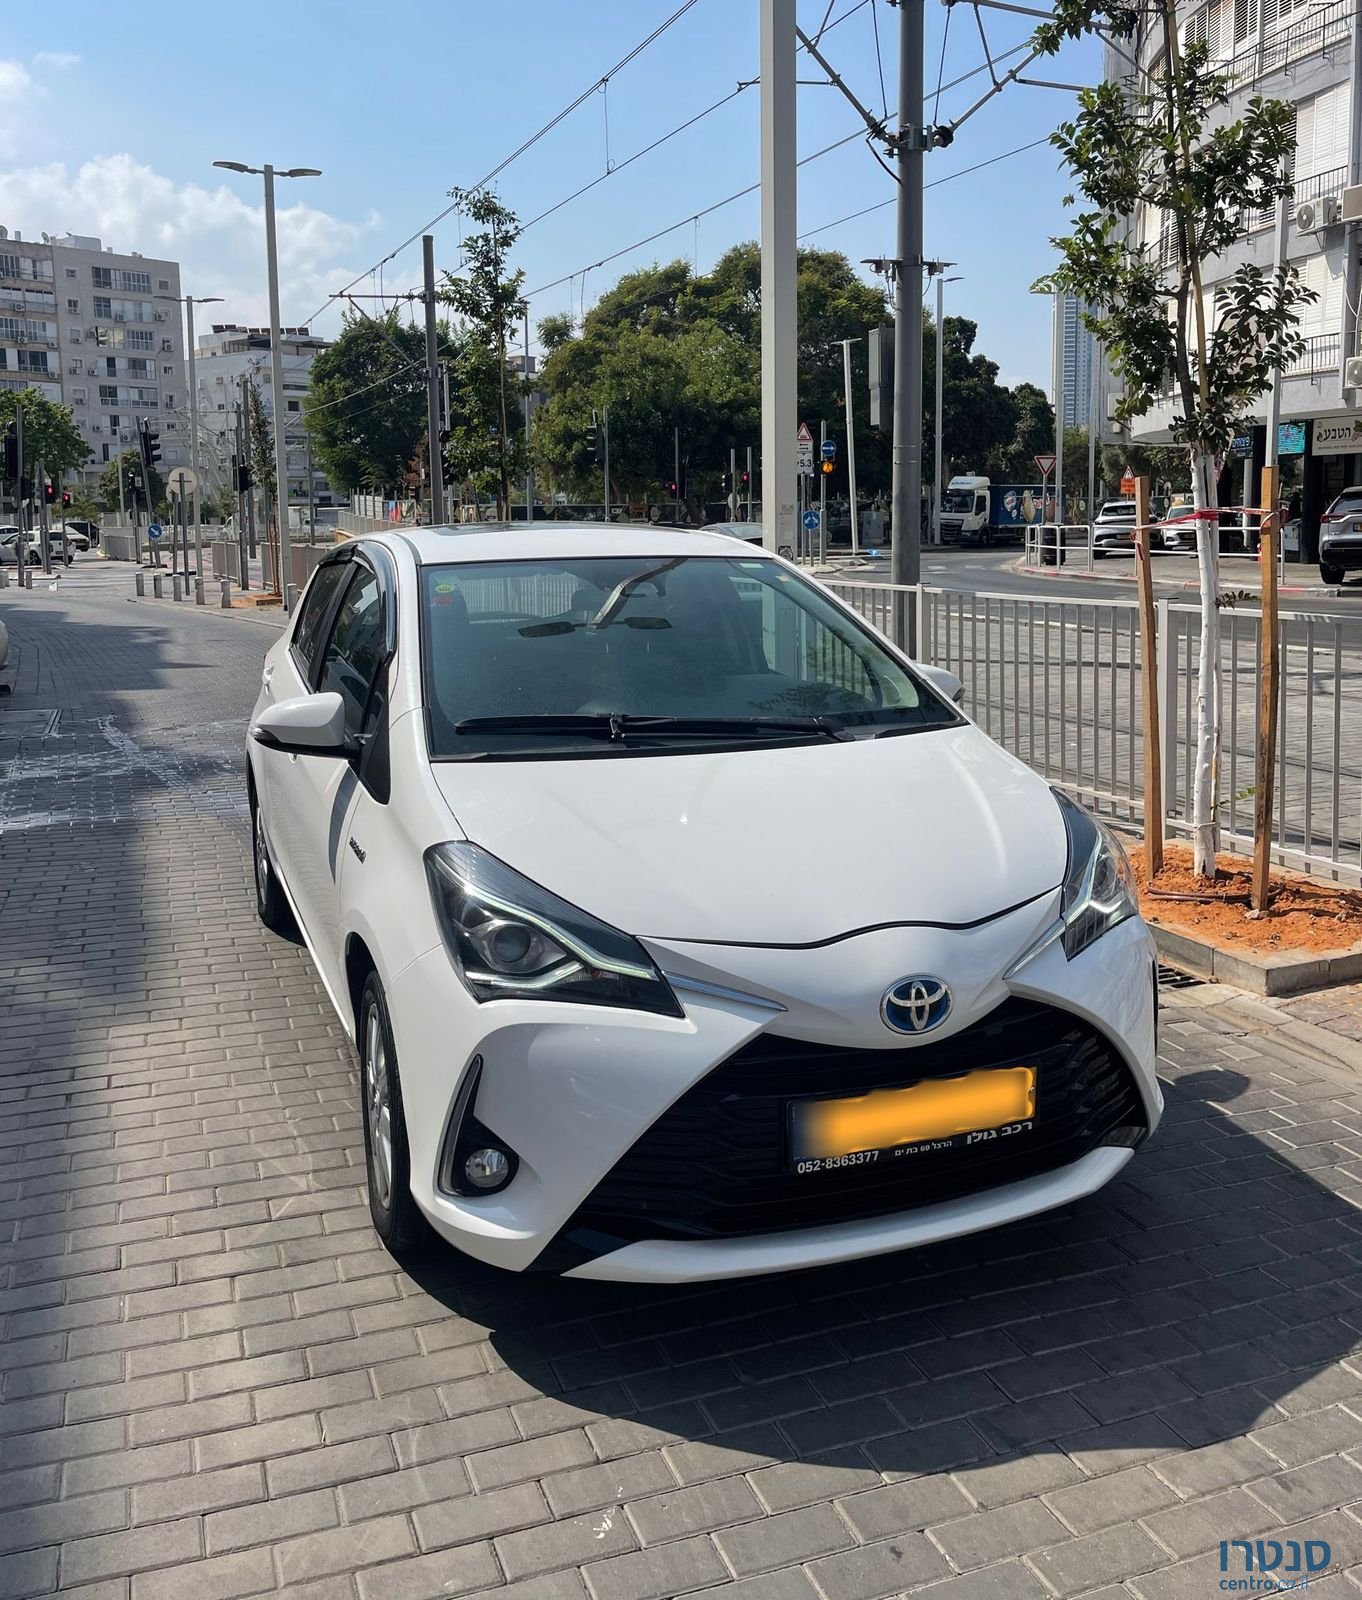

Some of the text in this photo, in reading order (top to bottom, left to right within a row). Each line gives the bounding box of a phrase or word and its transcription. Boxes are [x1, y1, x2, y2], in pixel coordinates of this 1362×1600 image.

[1323, 427, 1351, 441] הטבע
[800, 459, 812, 467] 5.3
[1001, 1121, 1033, 1136] רכב
[967, 1130, 997, 1145] גולן
[905, 1147, 918, 1155] בת
[931, 1140, 953, 1150] הרצל
[894, 1149, 904, 1157] ים
[797, 1150, 880, 1174] 052-8363377
